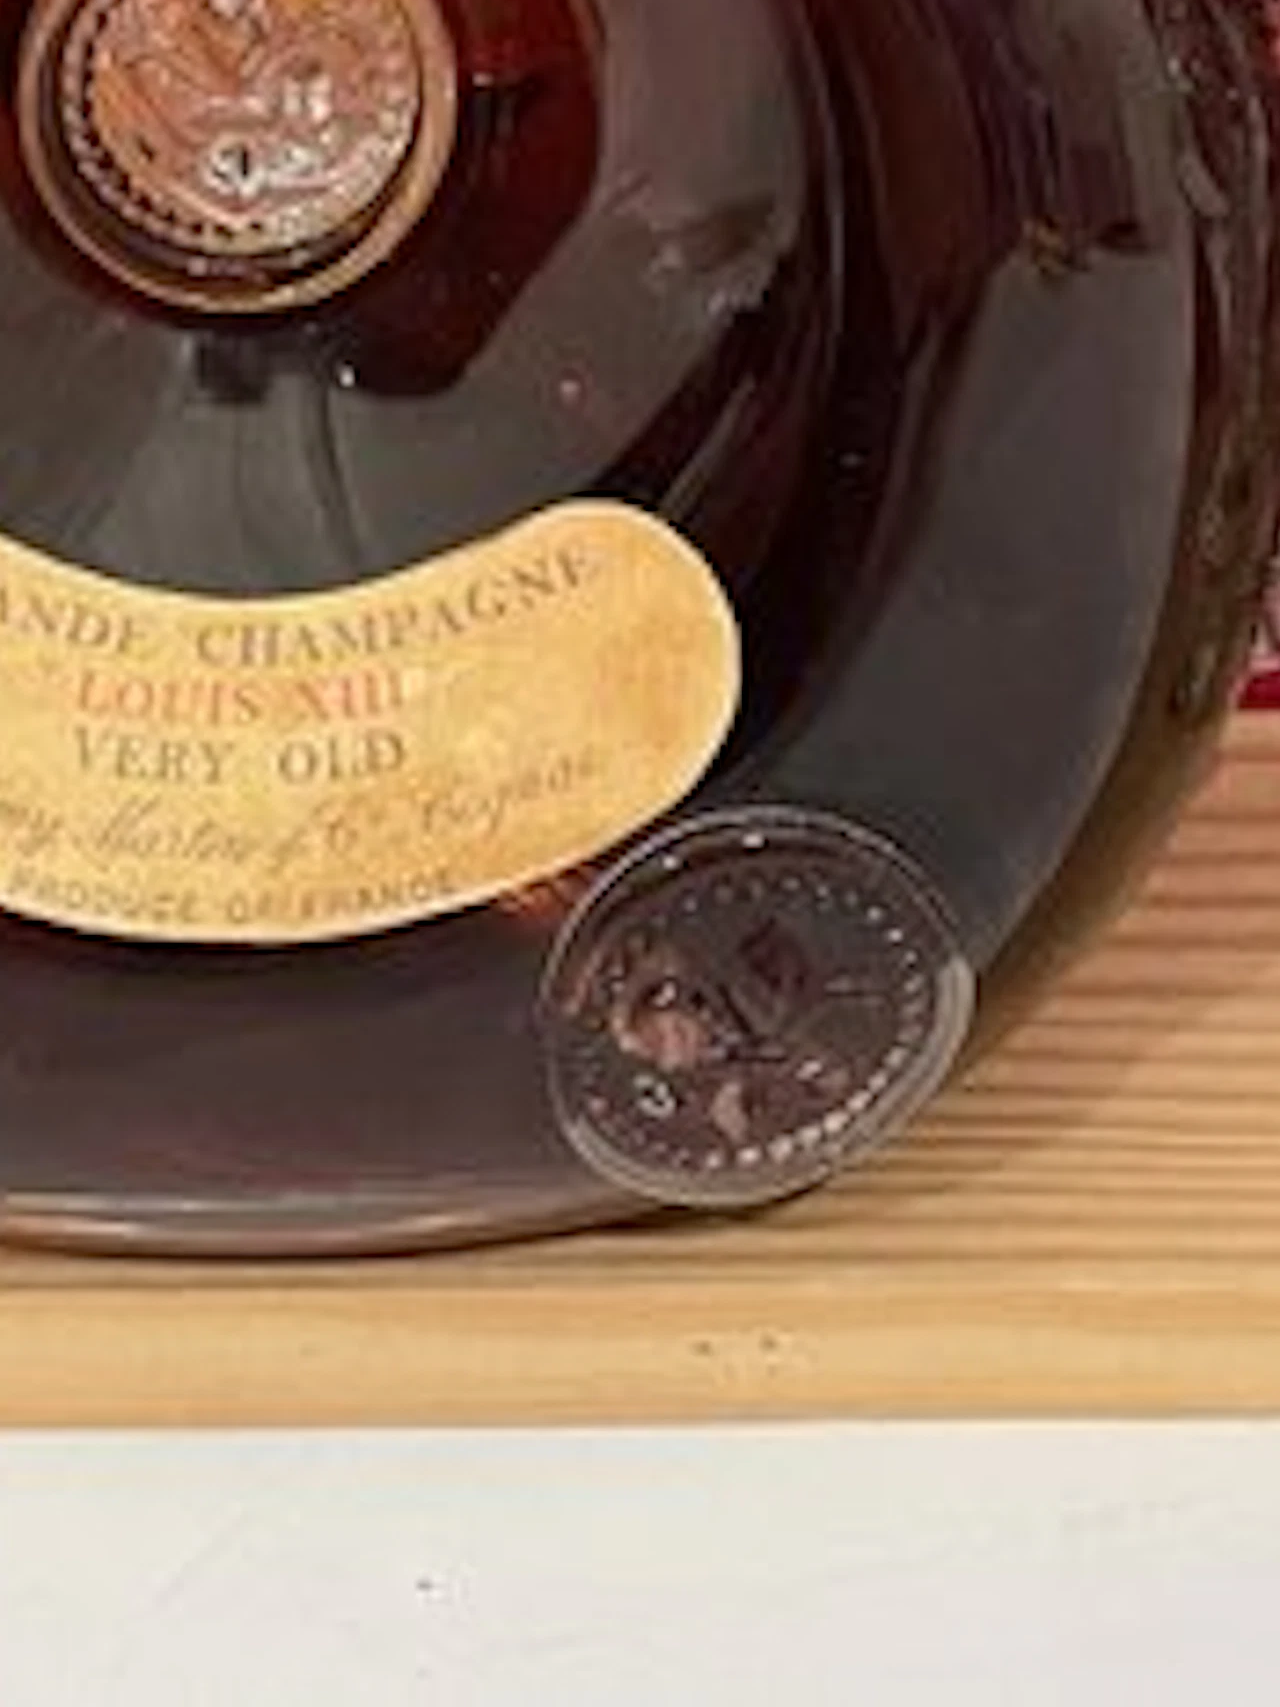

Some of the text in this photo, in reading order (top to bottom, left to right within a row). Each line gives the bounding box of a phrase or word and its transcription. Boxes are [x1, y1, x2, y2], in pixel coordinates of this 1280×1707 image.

[196, 545, 602, 667] CHAMPAGNE
[76, 667, 405, 726] LOUIS XIII
[72, 725, 406, 784] VERY OLD
[9, 867, 456, 925] PRODUCE OF FRANCE
